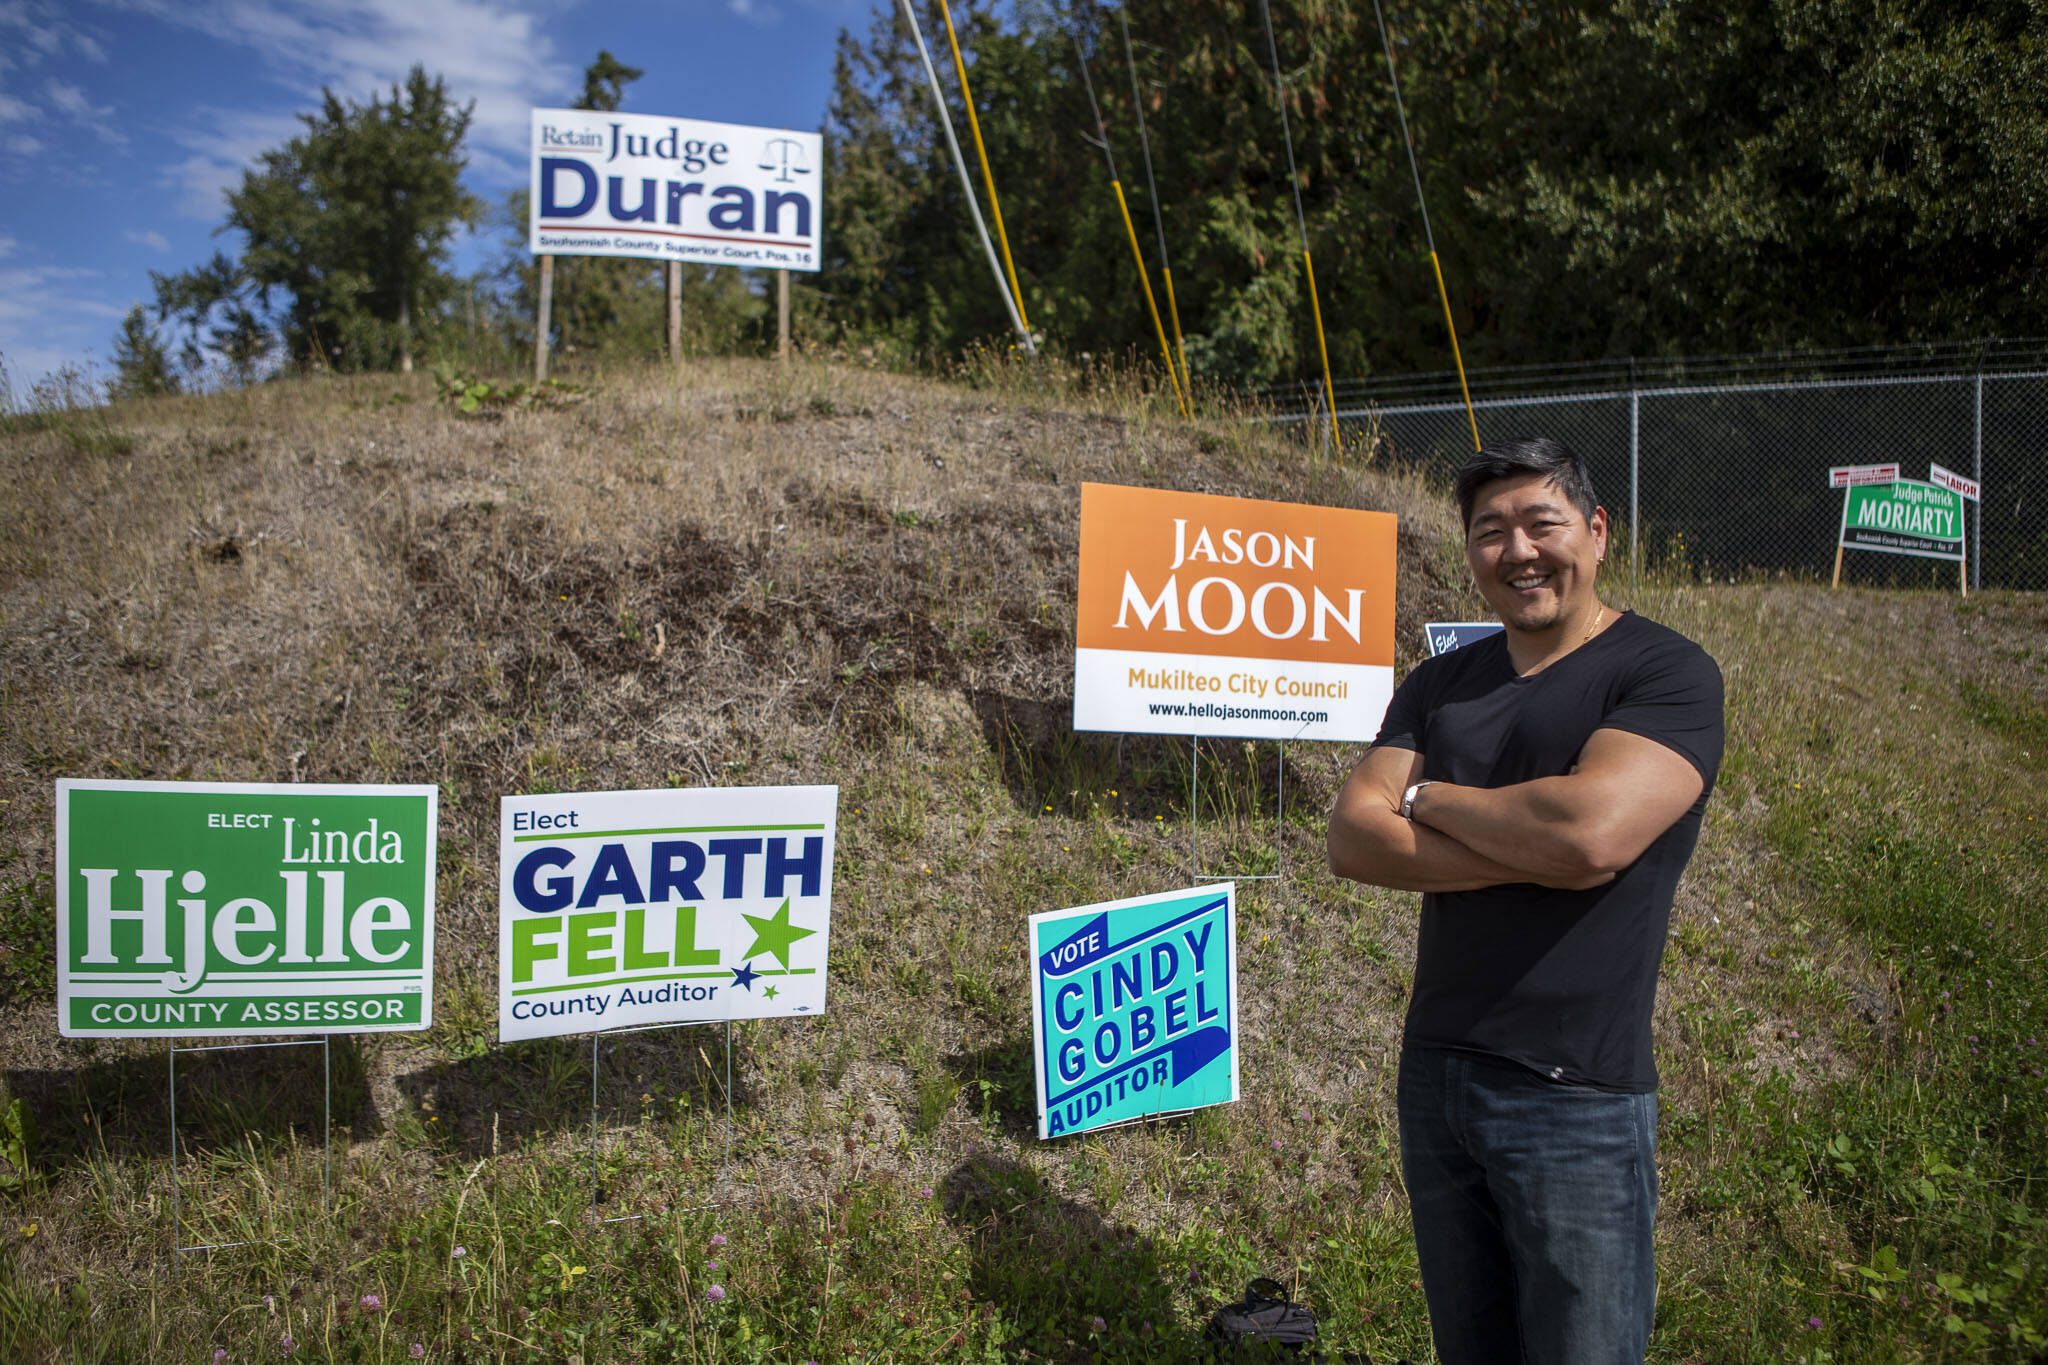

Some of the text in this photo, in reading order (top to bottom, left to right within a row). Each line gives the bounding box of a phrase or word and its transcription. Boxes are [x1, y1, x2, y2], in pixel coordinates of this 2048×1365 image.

[541, 123, 729, 173] Retain Judge
[540, 157, 811, 237] Duran
[540, 236, 611, 248] Snohomish
[614, 238, 660, 251] County
[665, 241, 718, 257] Superior
[1857, 497, 1954, 536] MORIARTY
[1893, 482, 1954, 508] Judge Patrick
[1169, 518, 1316, 572] JASON
[1112, 569, 1367, 645] MOON
[1128, 667, 1348, 699] Mukilteo City Council
[1149, 702, 1329, 722] www.hellojasonmoon.com
[208, 813, 405, 864] ELECT Linda
[513, 810, 579, 831] Elect
[513, 836, 824, 913] GARTH
[80, 868, 412, 993] Hjelle
[512, 906, 721, 983] FELL
[1050, 931, 1100, 969] VOTE
[512, 982, 718, 1020] County Auditor
[1054, 920, 1213, 1034] CINDY
[91, 999, 404, 1024] COUNTY ASSESSOR
[1058, 980, 1218, 1086] GOBEL
[1049, 1057, 1169, 1137] AUDITOR
